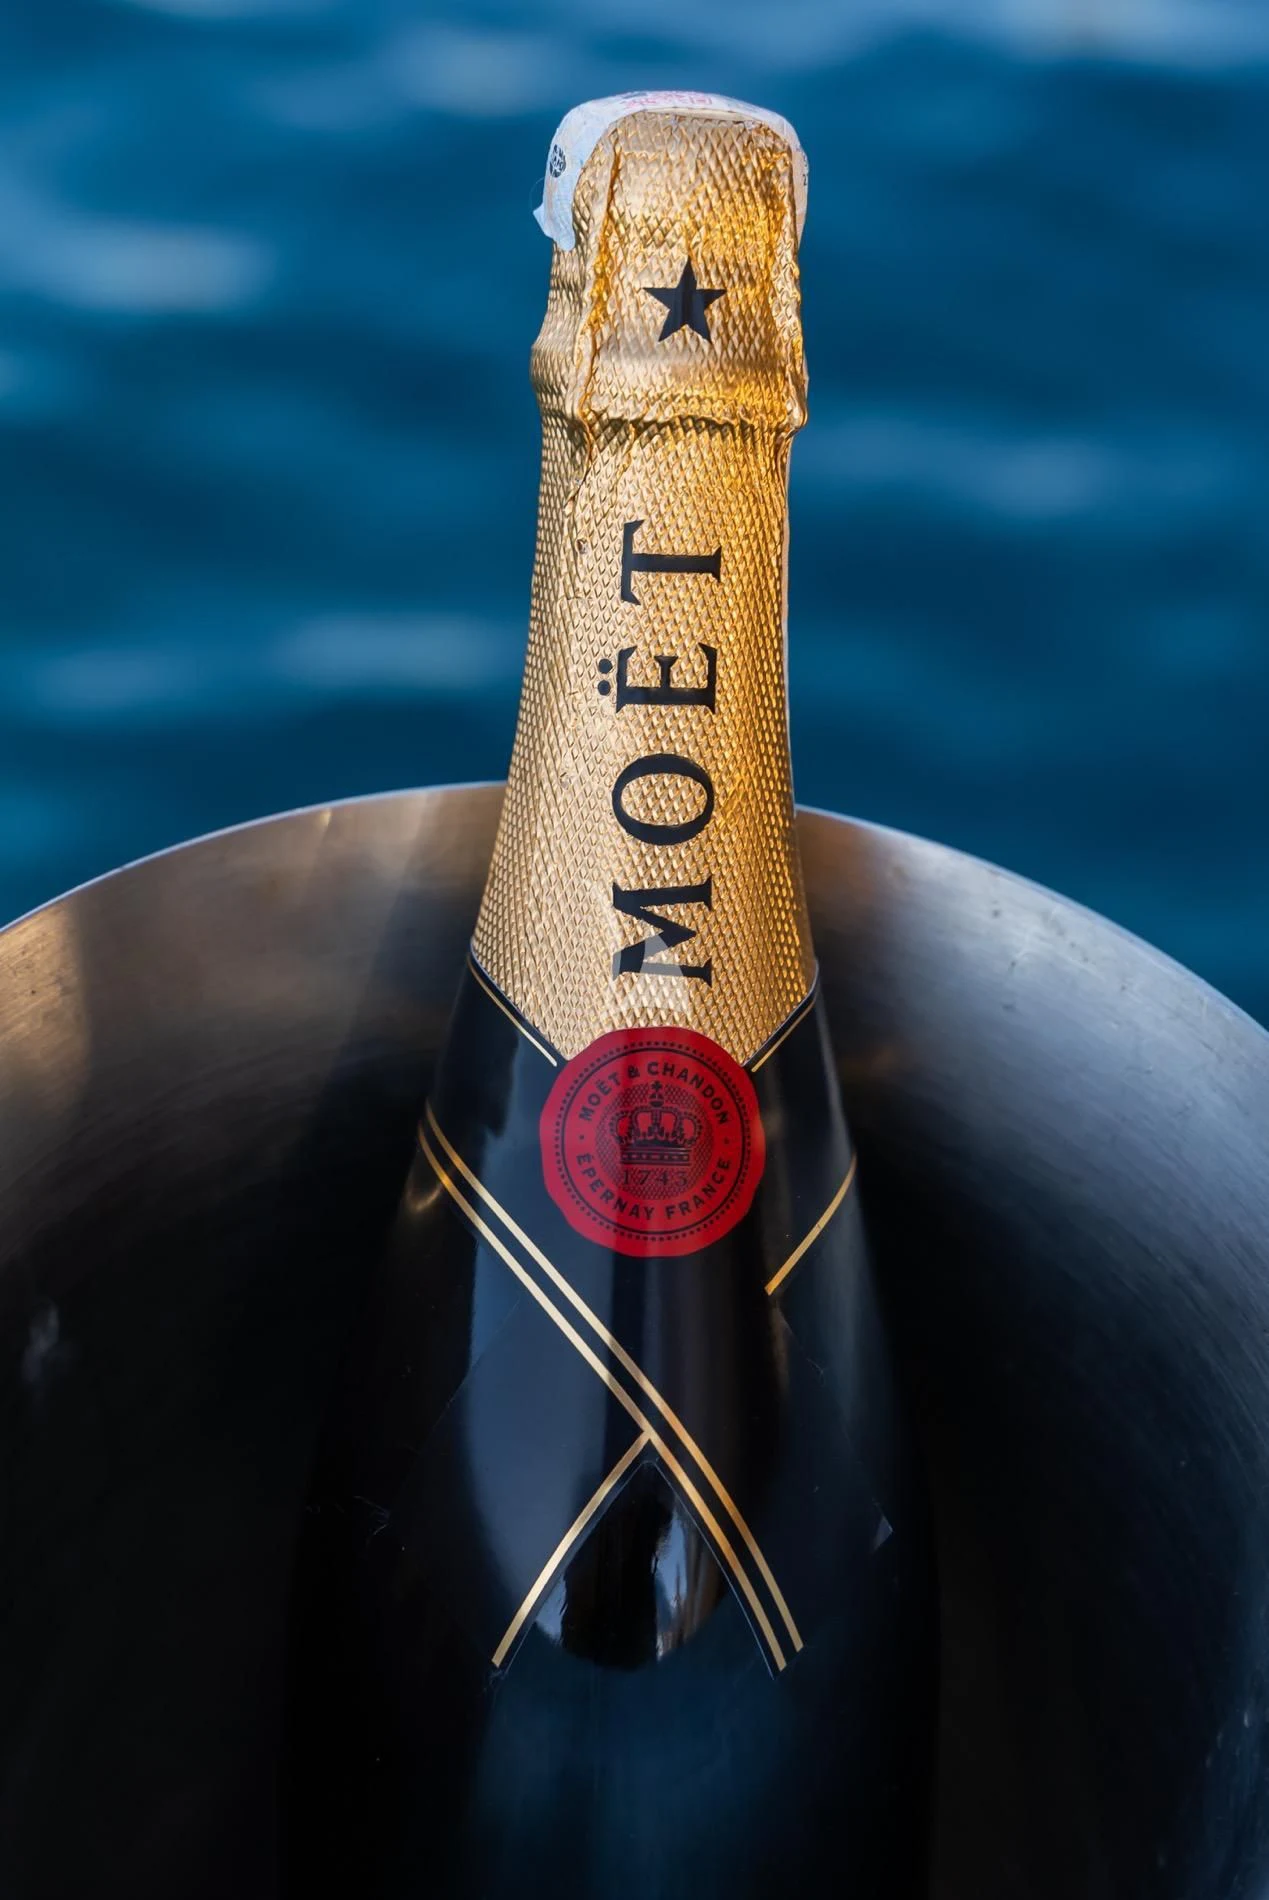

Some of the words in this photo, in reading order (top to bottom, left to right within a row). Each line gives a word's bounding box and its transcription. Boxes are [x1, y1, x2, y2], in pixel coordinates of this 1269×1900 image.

[598, 519, 722, 988] MOËT
[627, 1064, 640, 1078] &
[647, 1062, 729, 1124] CHANDON
[576, 1153, 654, 1220] ÉPERNAY
[665, 1159, 730, 1219] FRANCE
